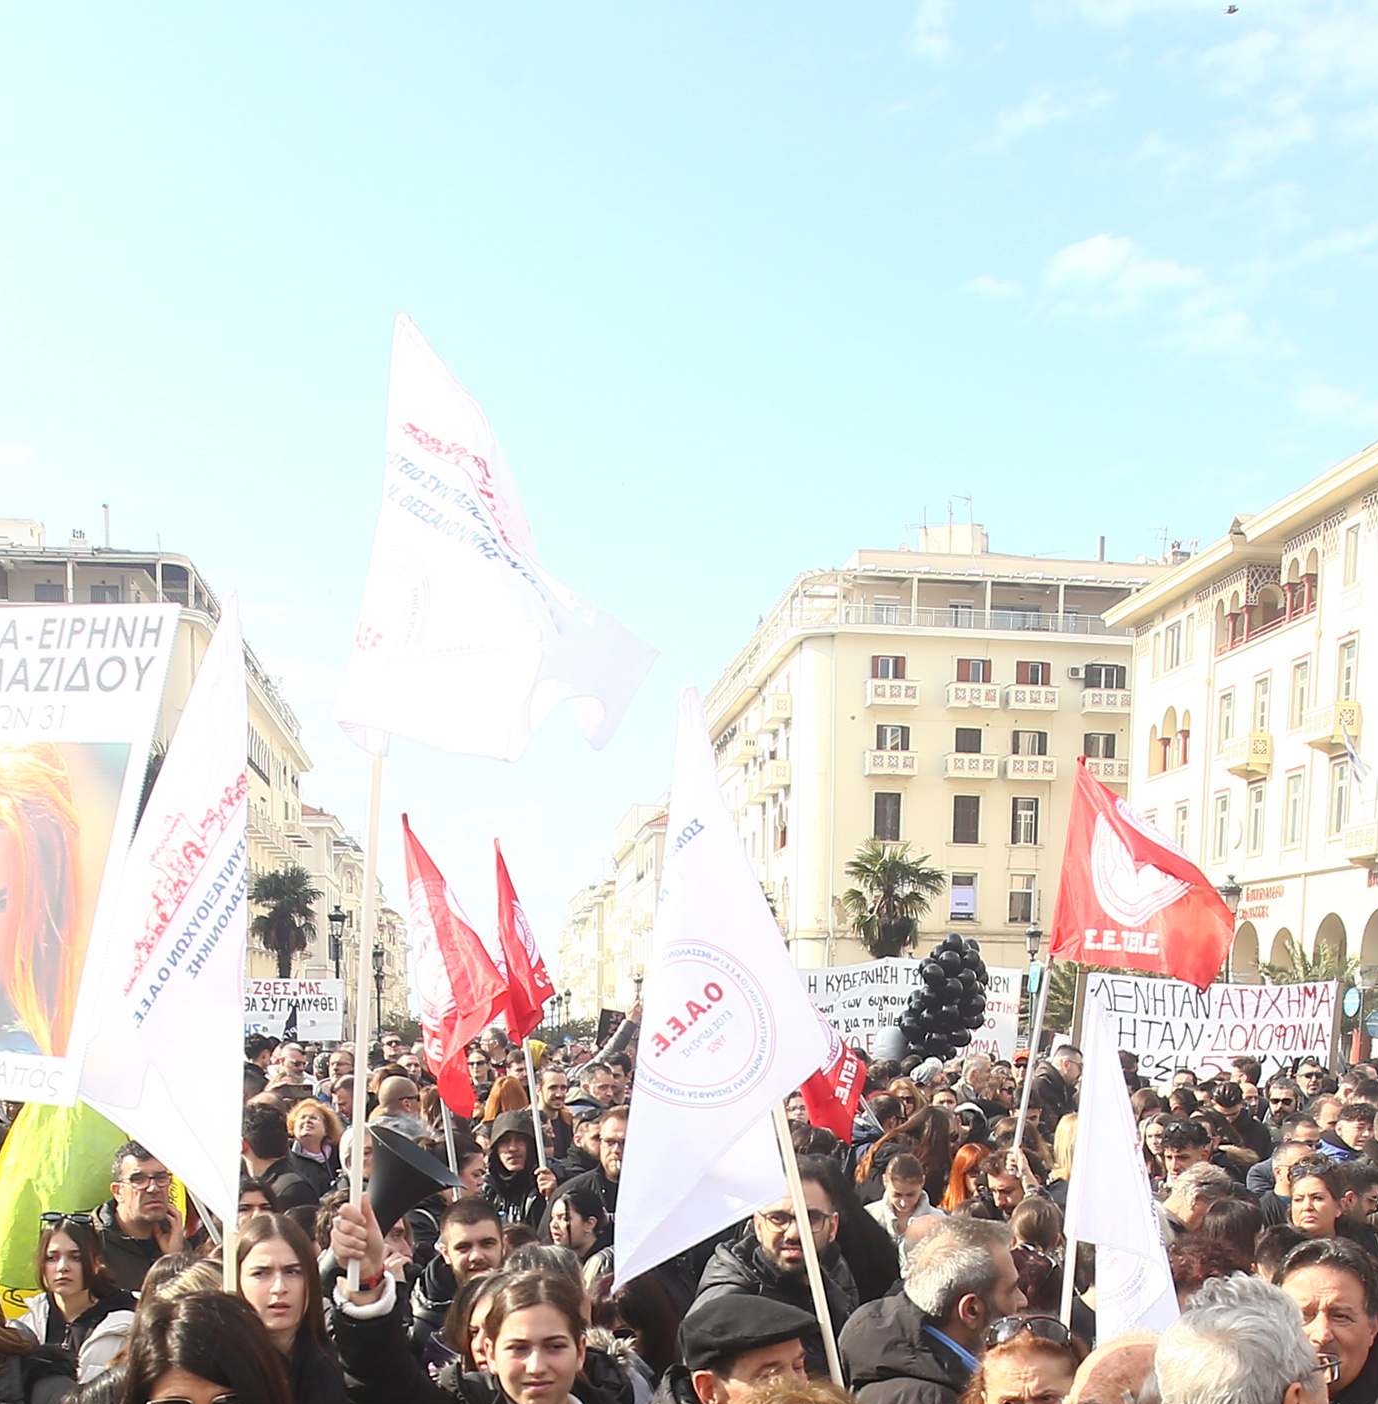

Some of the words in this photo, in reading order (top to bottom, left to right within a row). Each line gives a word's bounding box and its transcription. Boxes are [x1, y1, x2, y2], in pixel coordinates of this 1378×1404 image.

[40, 703, 67, 730] 31
[252, 981, 291, 996] ΖΩΕΣ
[808, 975, 818, 994] Η
[825, 964, 899, 997] ΚΥΒΕΡΝΗΣΗ
[903, 966, 922, 987] ΤΩ
[1218, 984, 1331, 1019] ΑΤΥΧΗΜΑ
[1119, 1017, 1204, 1051] ΗΤΑΝ
[1211, 1022, 1327, 1051] ΔΟΛΟΦΟΝΙΑ
